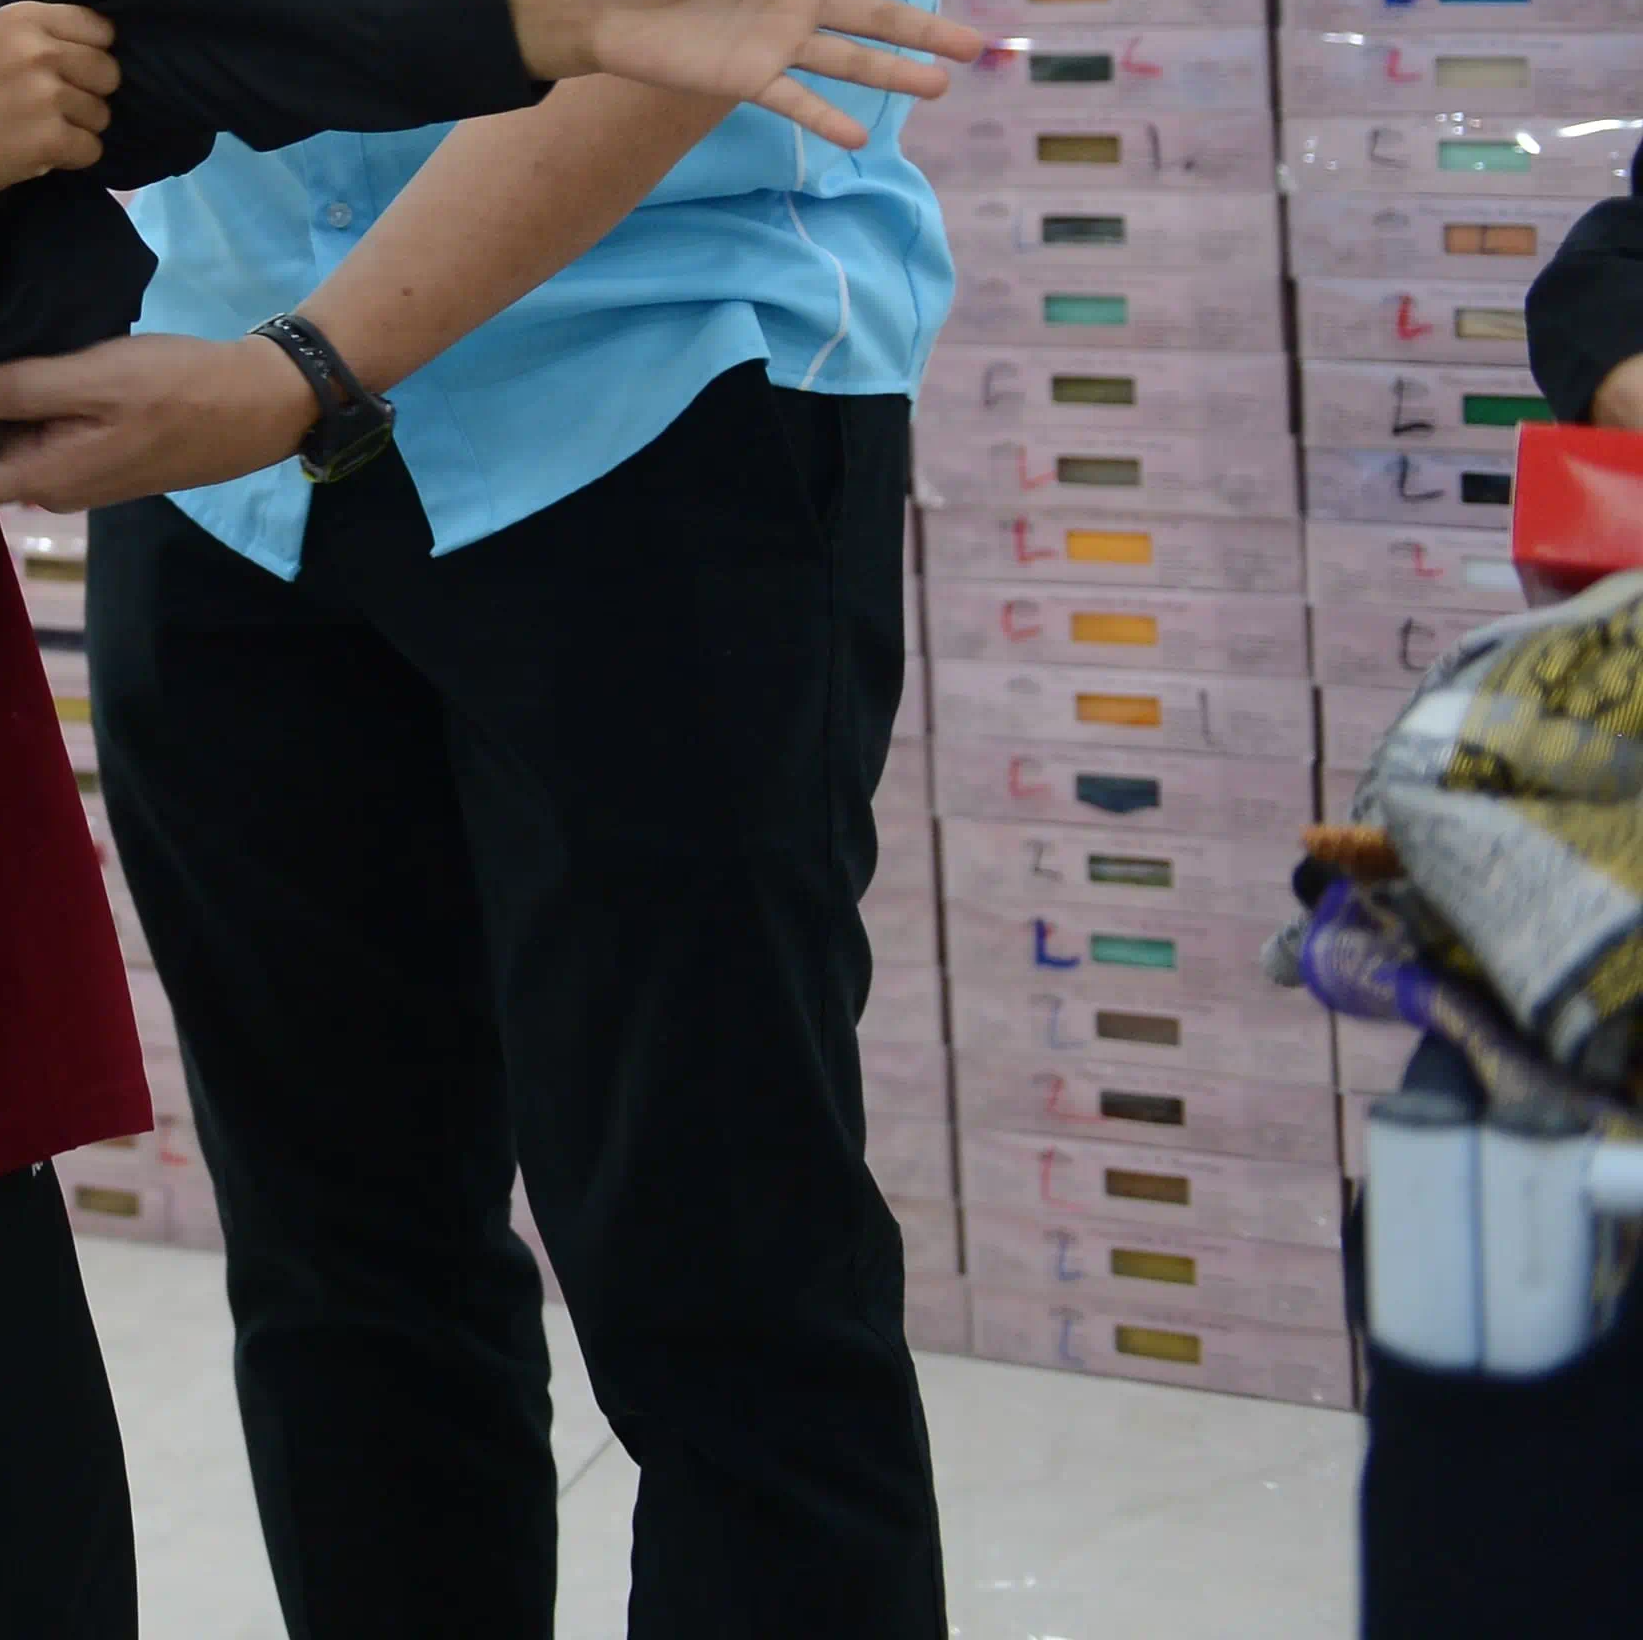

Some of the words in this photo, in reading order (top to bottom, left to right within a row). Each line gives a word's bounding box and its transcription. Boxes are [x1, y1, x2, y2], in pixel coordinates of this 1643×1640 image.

[1386, 47, 1422, 84] L
[1396, 294, 1433, 341] L
[1397, 455, 1446, 502] L
[1013, 514, 1056, 564] L
[1033, 917, 1081, 970] L
